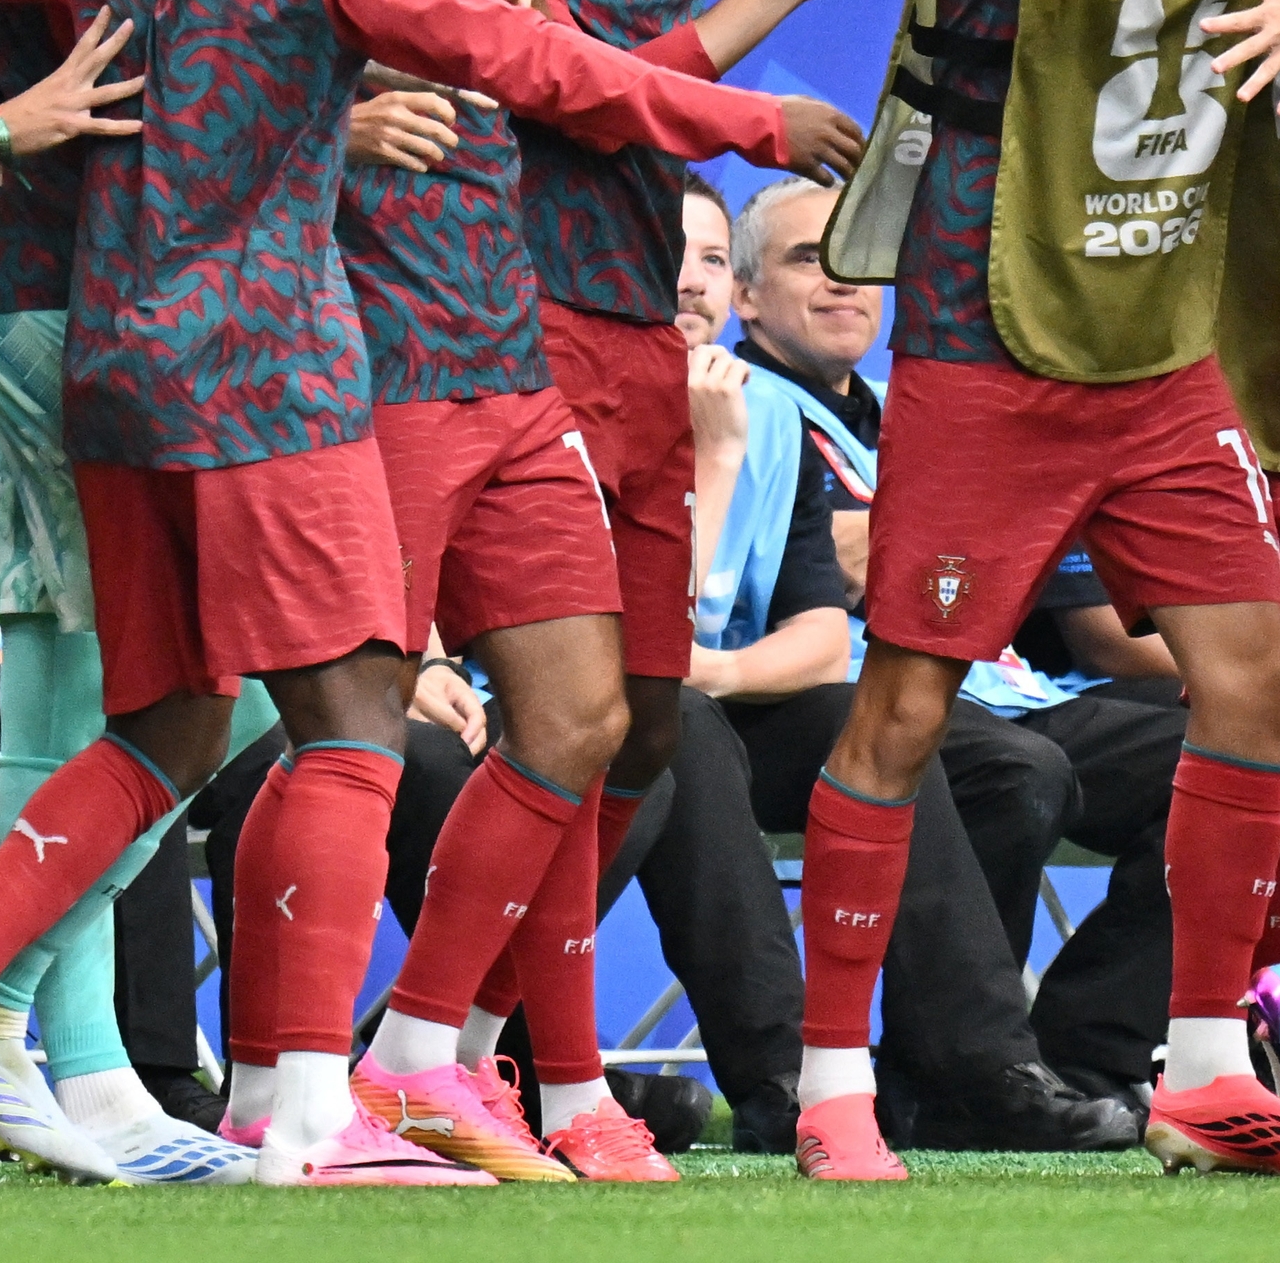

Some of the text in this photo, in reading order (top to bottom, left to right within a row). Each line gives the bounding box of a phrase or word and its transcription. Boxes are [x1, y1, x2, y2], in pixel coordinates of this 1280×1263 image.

[1135, 128, 1189, 158] FIFA
[1085, 190, 1179, 215] WORLD
[1083, 208, 1204, 257] 2026
